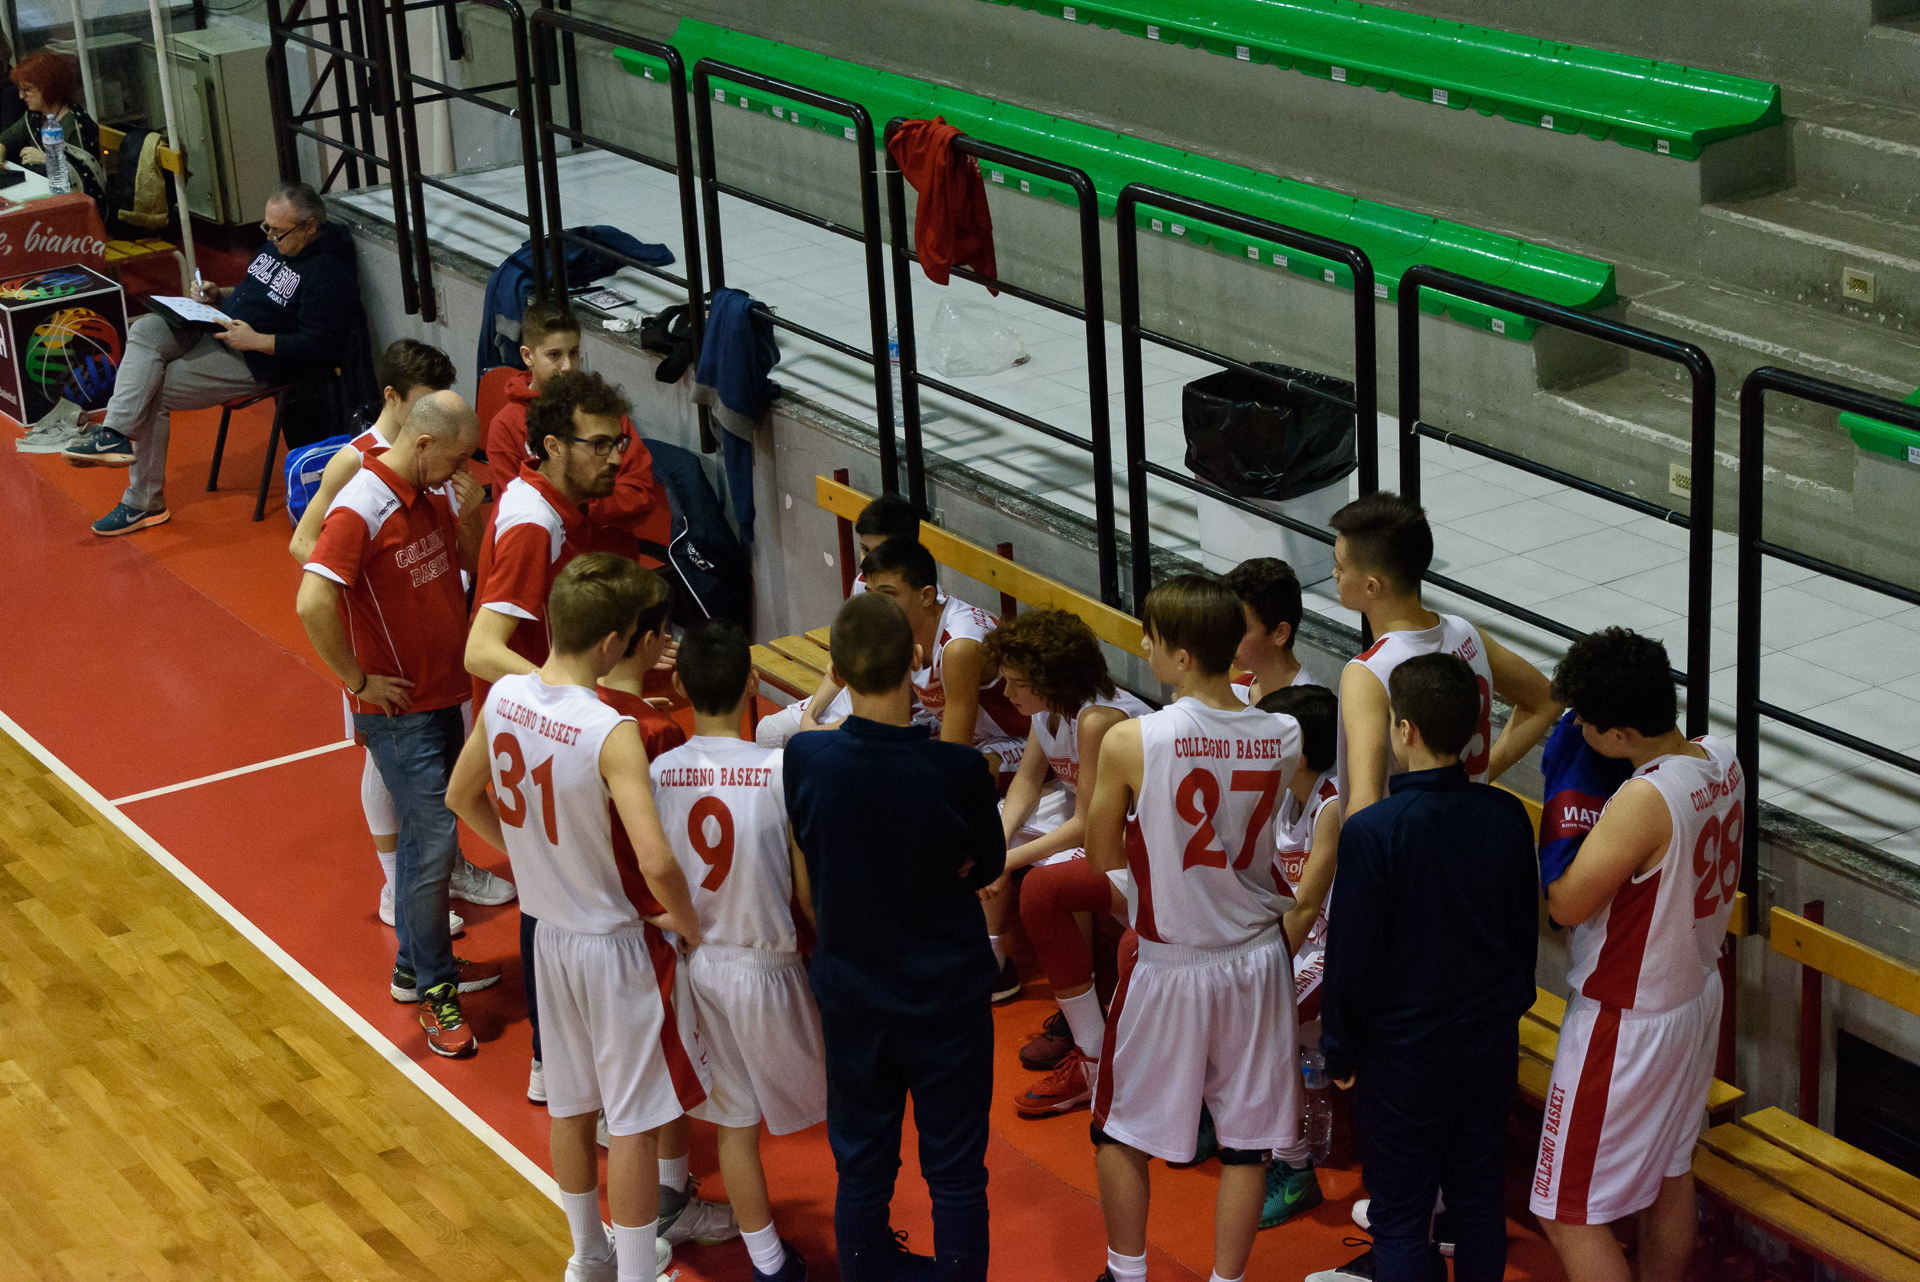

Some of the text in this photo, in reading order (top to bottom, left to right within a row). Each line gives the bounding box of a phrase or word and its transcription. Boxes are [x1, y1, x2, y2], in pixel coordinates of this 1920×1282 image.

[24, 221, 106, 257] bianca
[410, 551, 450, 588] BASKE
[496, 697, 582, 747] COLLEGNO BASKET
[1174, 737, 1282, 760] COLLEGNO BASKET
[493, 732, 559, 846] 31
[660, 768, 772, 788] COLLEGNO BASKET
[688, 796, 735, 892] 9
[1175, 768, 1282, 873] 27
[1693, 799, 1743, 920] 28
[1534, 1083, 1566, 1198] COLLEGNO BASKET
